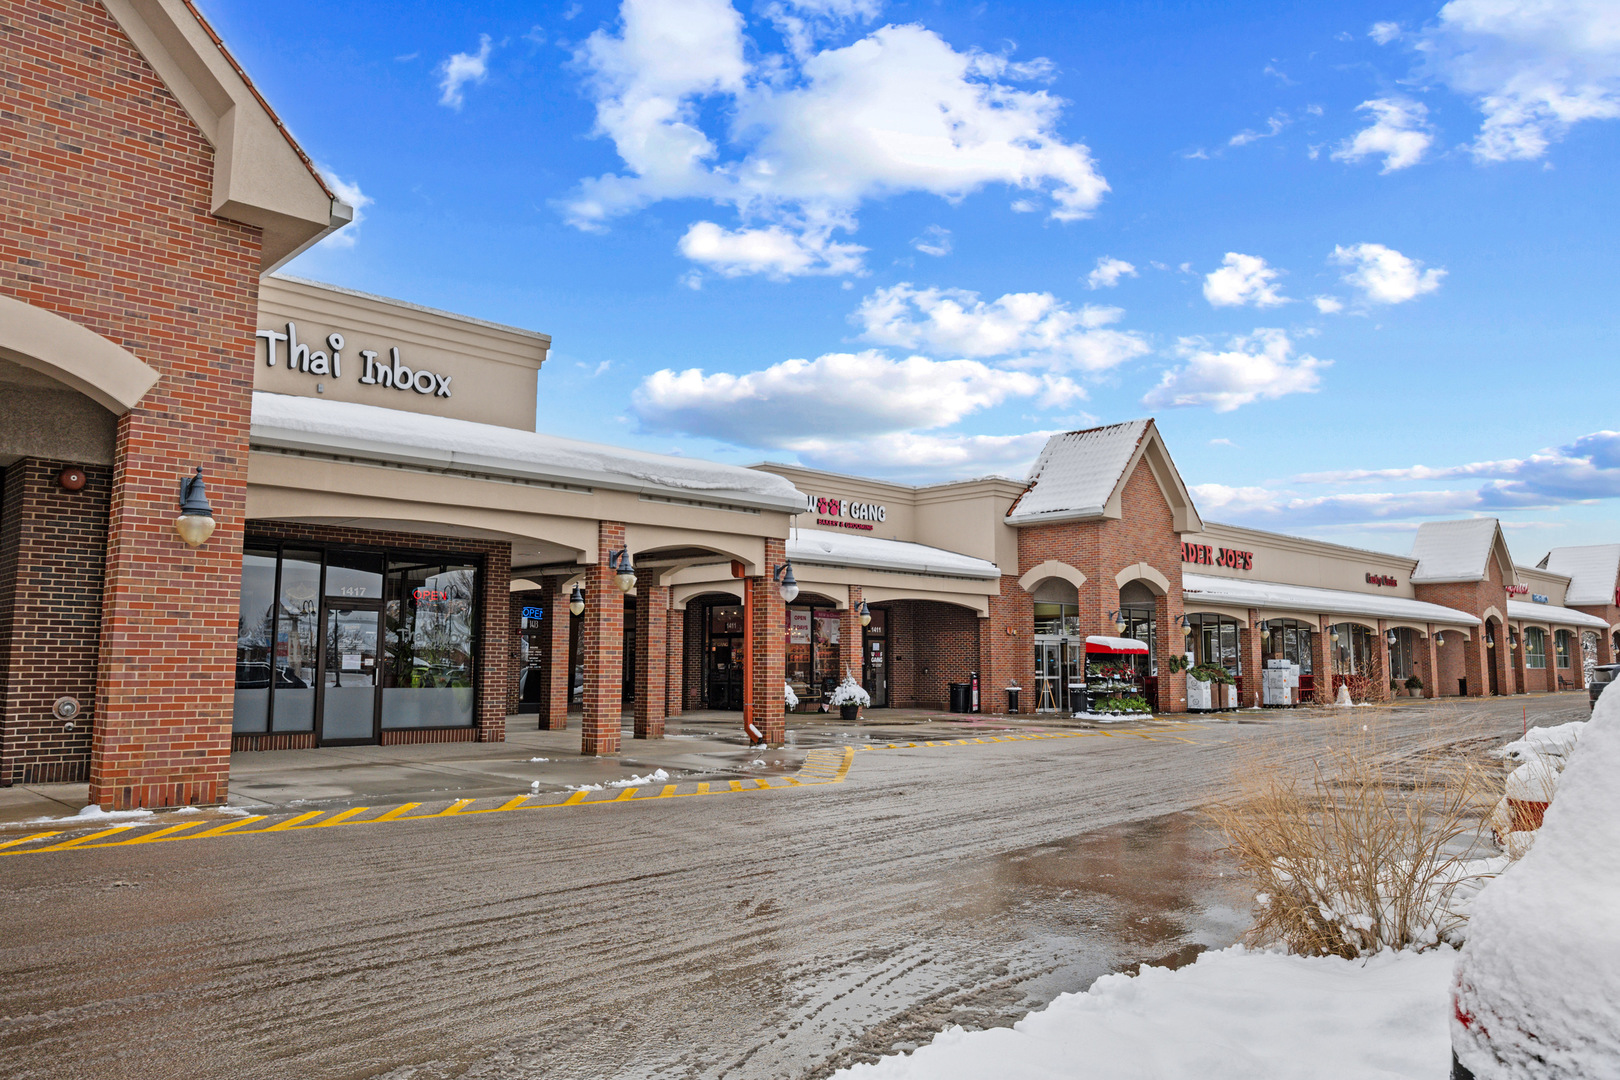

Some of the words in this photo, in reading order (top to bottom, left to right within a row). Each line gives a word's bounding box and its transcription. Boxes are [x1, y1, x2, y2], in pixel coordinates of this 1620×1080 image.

[256, 322, 345, 379] Thai
[359, 346, 453, 398] Inbox
[850, 502, 886, 522] GANG
[817, 518, 839, 527] BAKERY
[845, 522, 874, 531] GROOMING
[1216, 547, 1253, 570] JOE'S
[340, 586, 366, 597] 1417
[413, 590, 447, 601] OPEN
